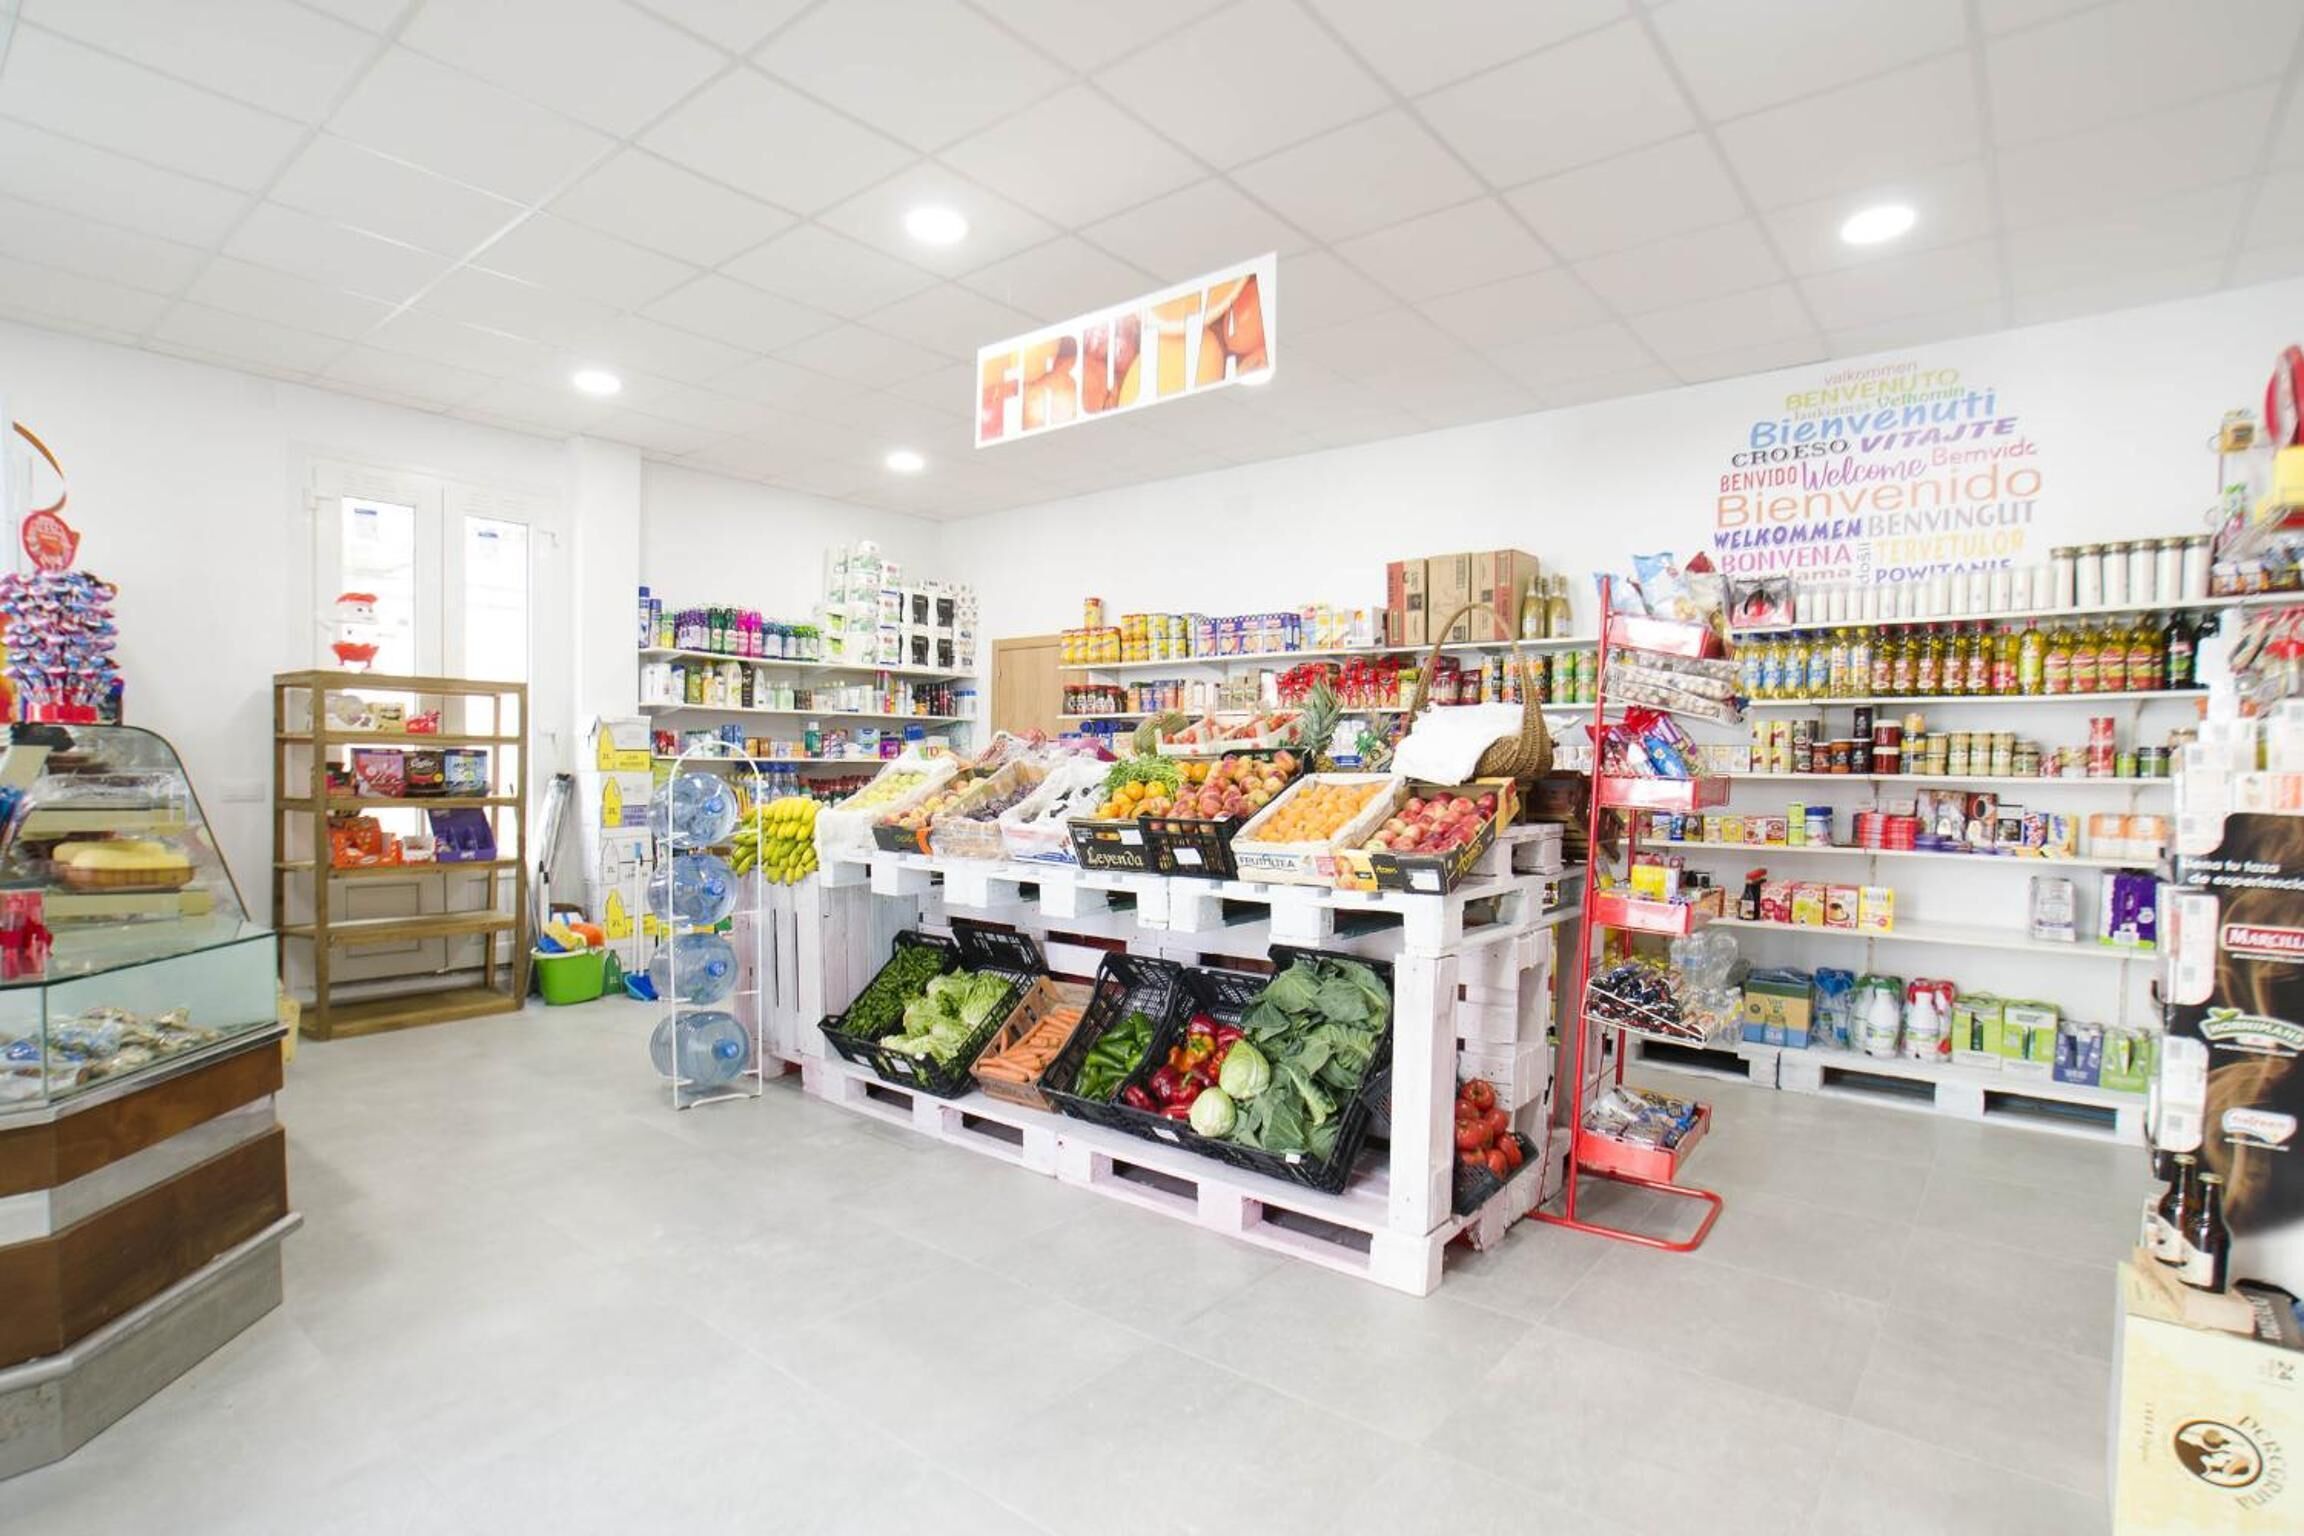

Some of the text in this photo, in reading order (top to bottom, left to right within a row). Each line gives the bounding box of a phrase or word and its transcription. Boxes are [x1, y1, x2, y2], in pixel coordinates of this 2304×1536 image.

[980, 272, 1269, 442] FRUTA
[1785, 368, 1960, 412] BENVENUTO
[1731, 416, 2019, 469] CROESO VITAJTE
[1750, 388, 1997, 451] Bienvenuti
[1717, 464, 2042, 530] Bienvenido
[1719, 465, 1798, 494] BENVIDO
[1801, 456, 1929, 492] Welcome
[1714, 499, 2038, 552] WELKOMMEN BENVINGUT
[1721, 542, 1852, 576] BONVENA
[1087, 845, 1145, 869] Leyenda
